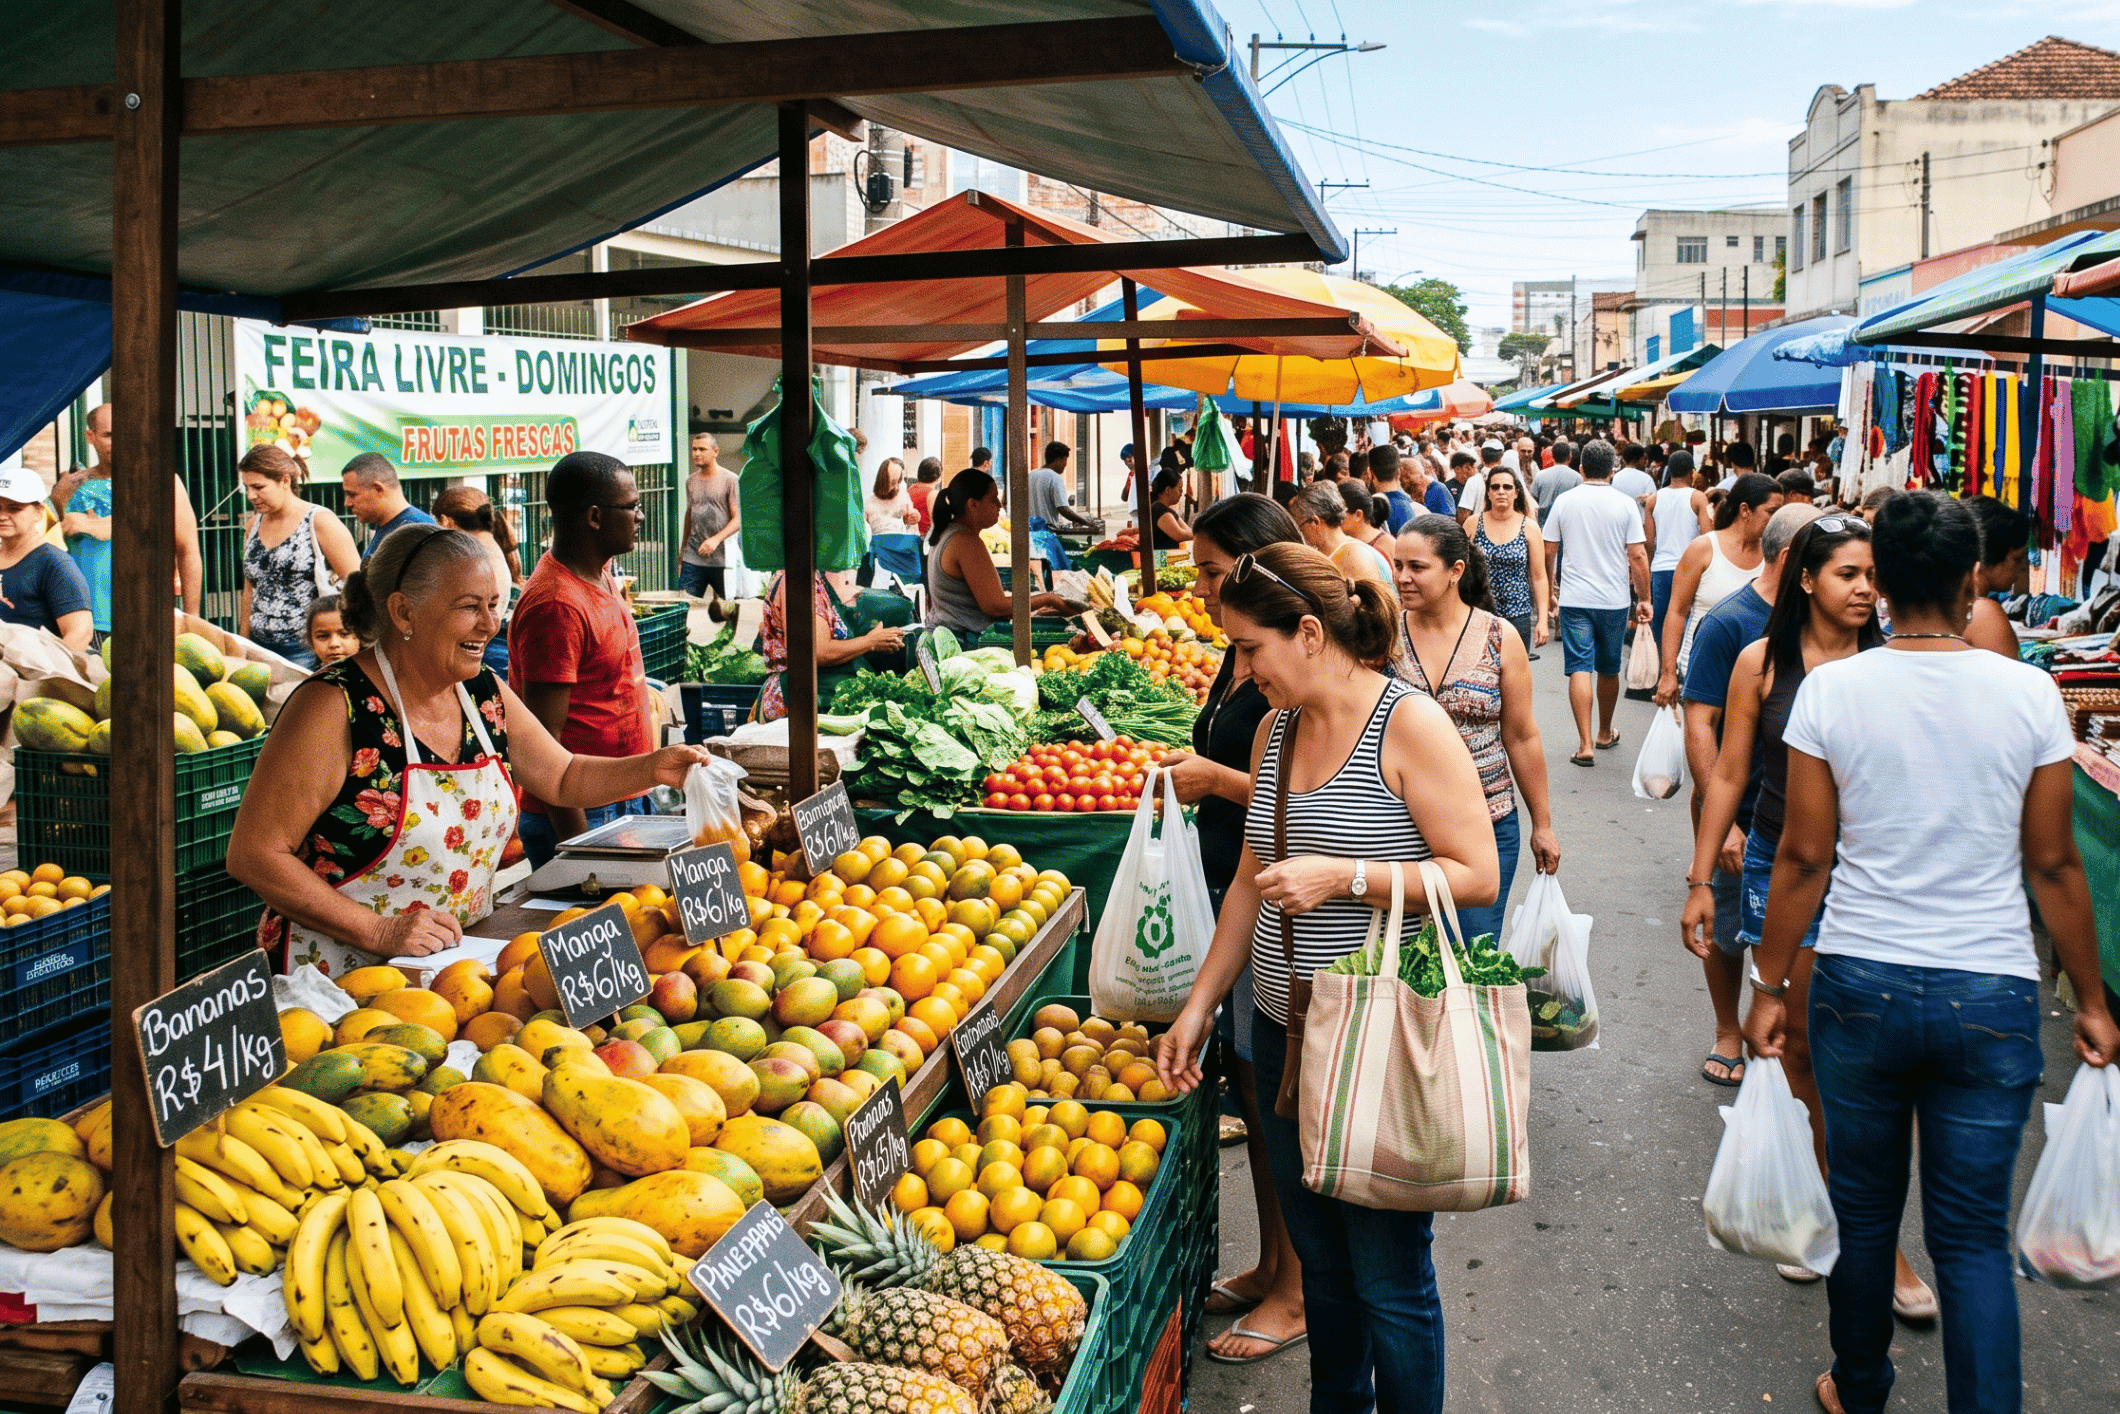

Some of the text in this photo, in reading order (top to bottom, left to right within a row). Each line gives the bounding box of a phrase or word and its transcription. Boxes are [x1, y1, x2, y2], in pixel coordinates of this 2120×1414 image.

[264, 334, 385, 392] FEIRA
[394, 343, 489, 394] LIVRE
[515, 349, 656, 395] DOMINGOS
[402, 422, 575, 463] FRUTAS FRESCAS
[671, 856, 731, 889] Manga
[547, 919, 622, 967] Manga
[143, 968, 267, 1057] Bananas
